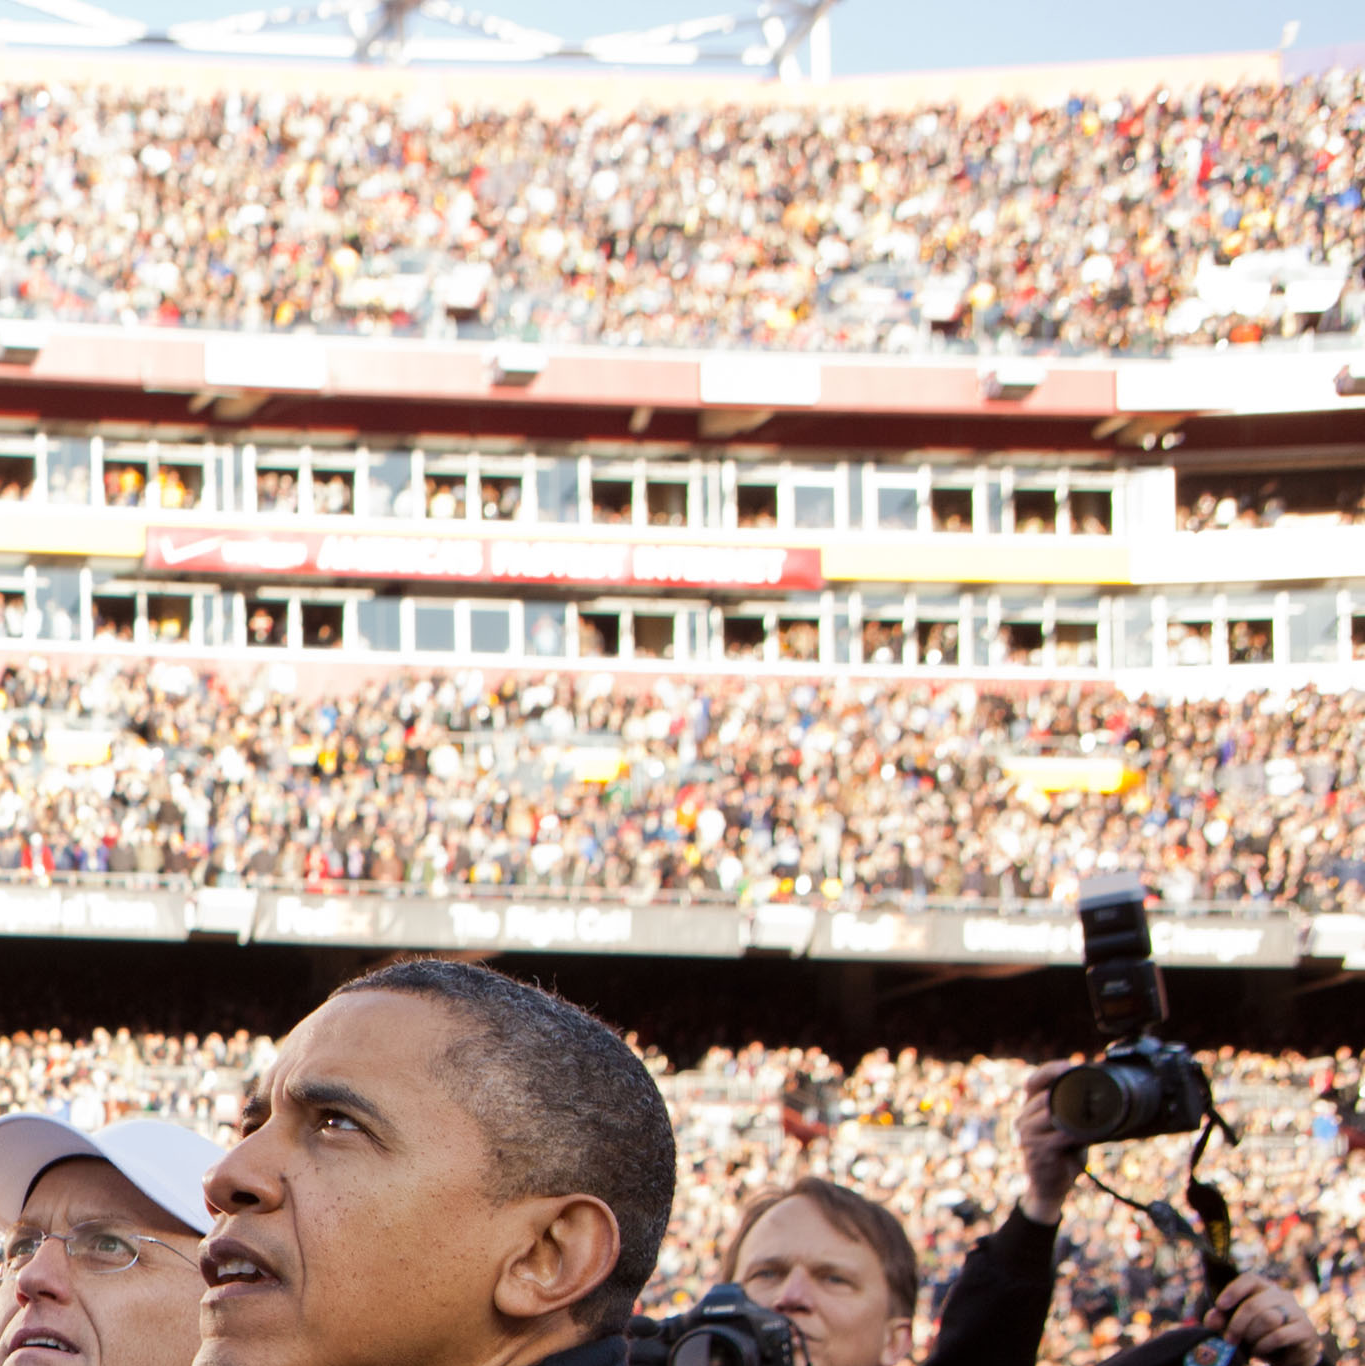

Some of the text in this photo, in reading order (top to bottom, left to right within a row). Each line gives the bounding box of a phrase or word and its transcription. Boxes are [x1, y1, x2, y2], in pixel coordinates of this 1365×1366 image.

[277, 898, 374, 937] FedEx
[450, 903, 500, 940] The
[830, 912, 929, 951] FedEx
